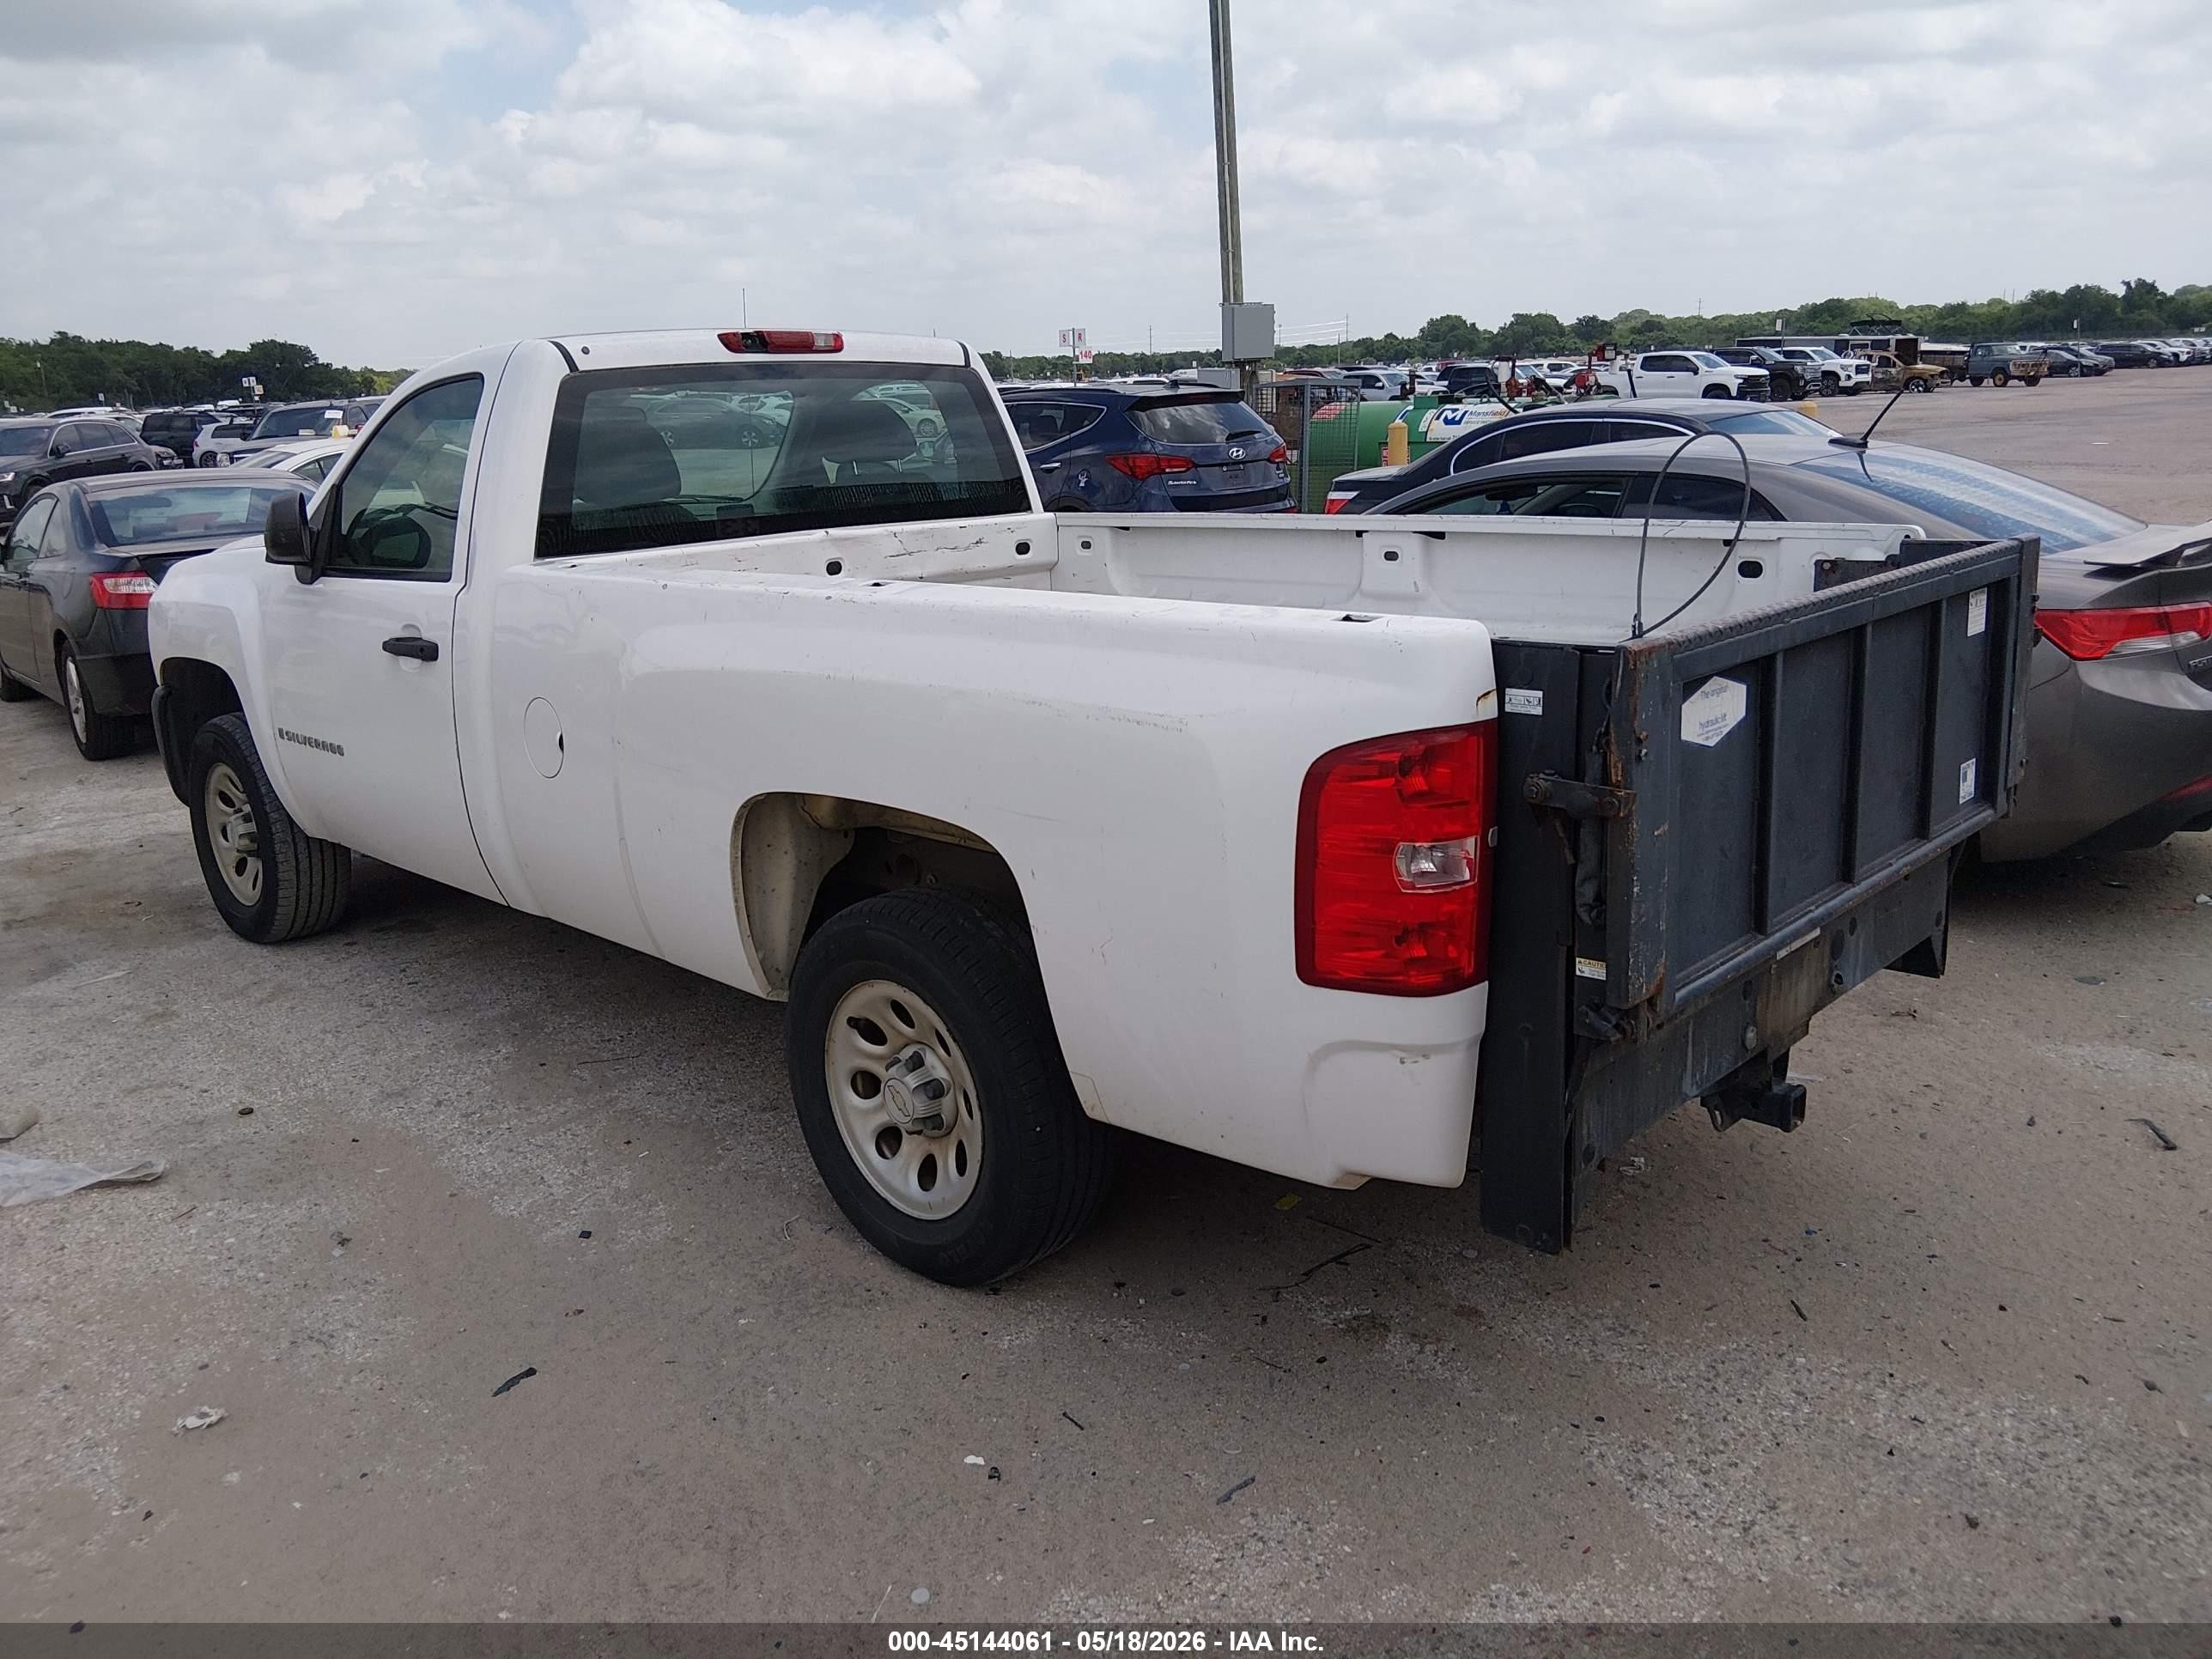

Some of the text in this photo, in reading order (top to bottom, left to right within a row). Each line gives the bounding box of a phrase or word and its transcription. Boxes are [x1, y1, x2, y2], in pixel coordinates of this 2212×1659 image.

[1079, 349, 1092, 360] 140
[1468, 410, 1507, 418] Mansfield
[285, 730, 345, 757] SILVERADO
